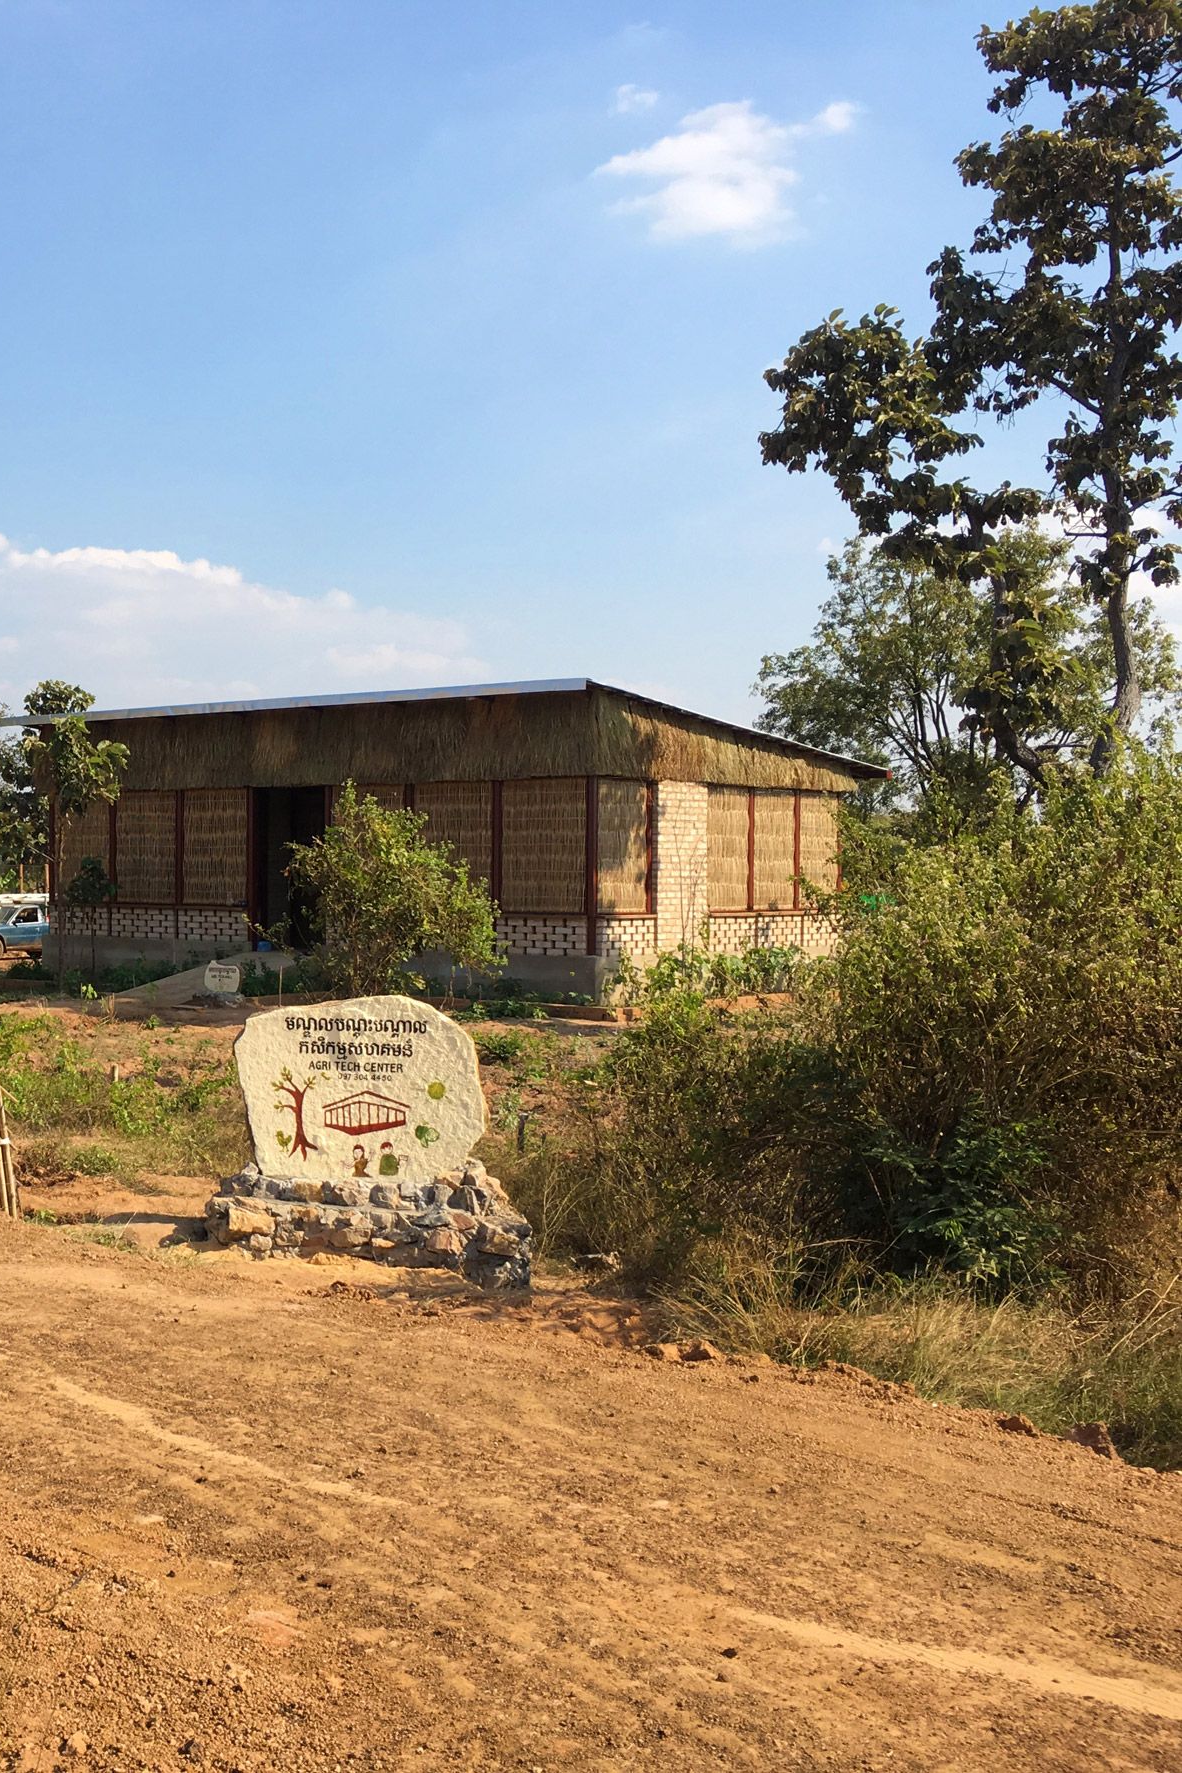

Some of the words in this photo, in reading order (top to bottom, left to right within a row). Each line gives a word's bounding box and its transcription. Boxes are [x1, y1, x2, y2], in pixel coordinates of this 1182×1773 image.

[309, 1060, 331, 1071] AGRI
[334, 1061, 361, 1072] TECH
[363, 1062, 404, 1073] CENTER
[338, 1072, 352, 1080] 097
[354, 1073, 368, 1081] 304
